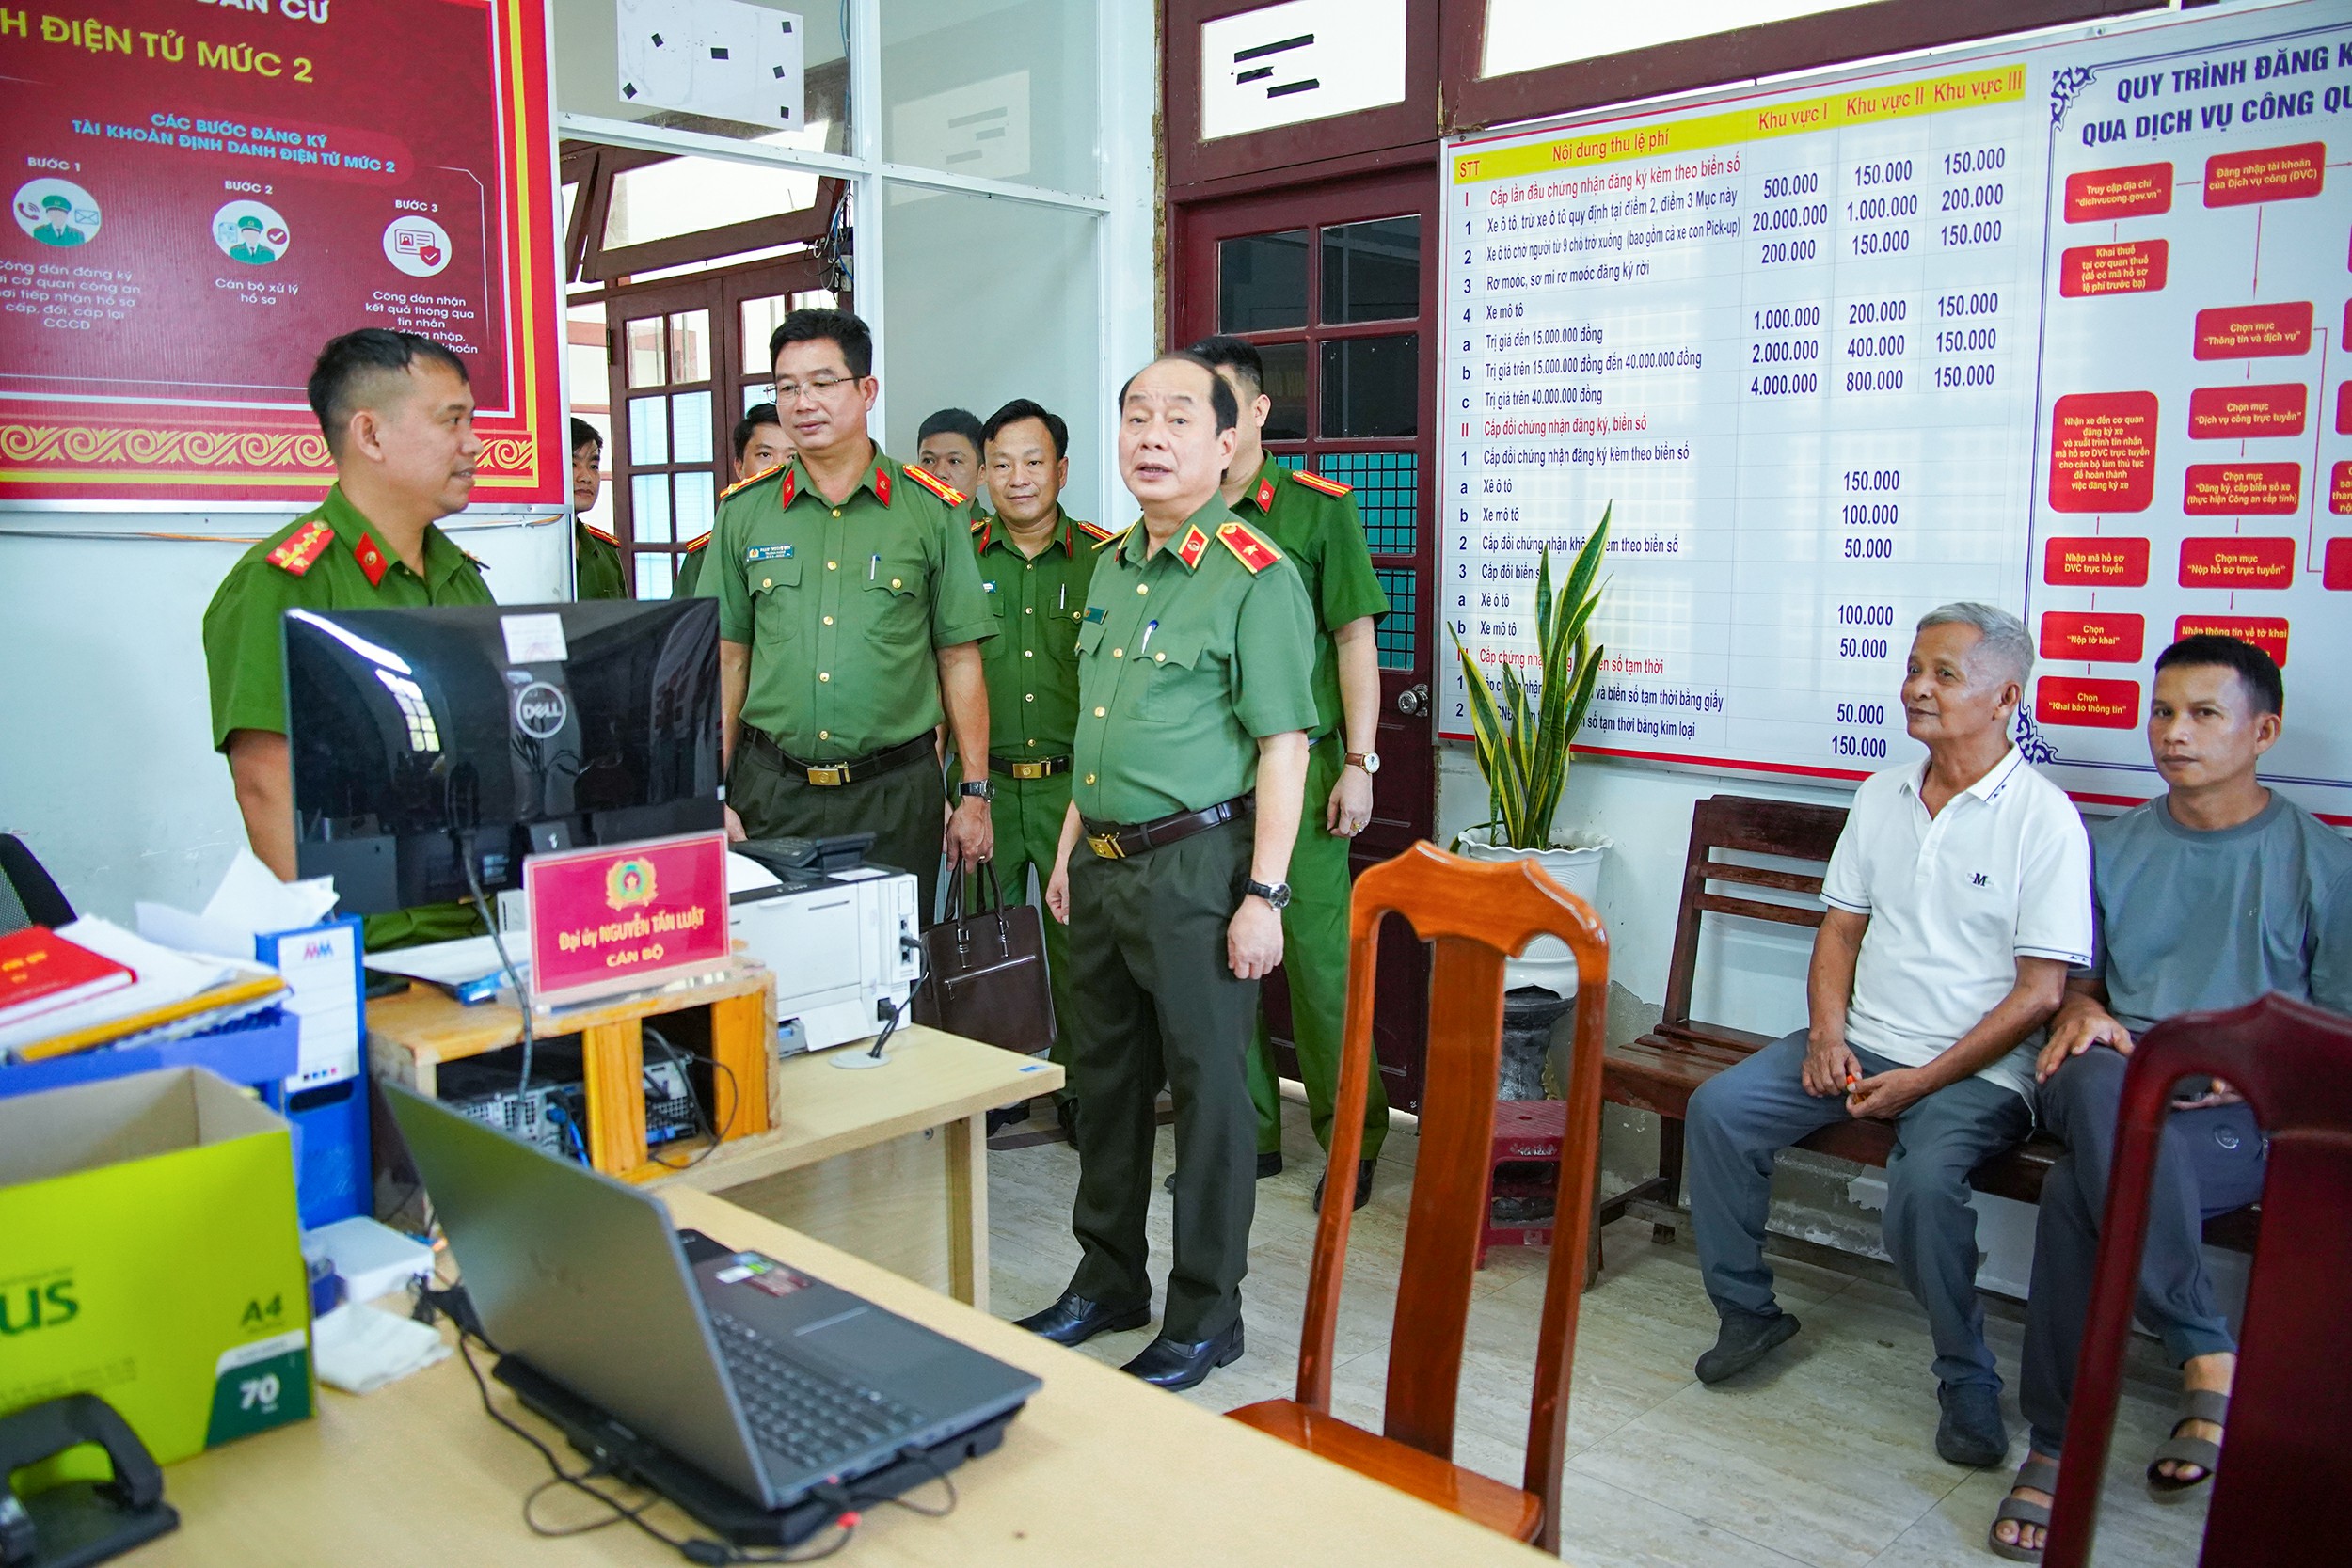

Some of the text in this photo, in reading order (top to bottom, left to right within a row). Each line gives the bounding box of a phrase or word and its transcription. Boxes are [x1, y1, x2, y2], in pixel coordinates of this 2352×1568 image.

[41, 15, 131, 54] ĐIỆN
[140, 29, 184, 61] TỬ
[197, 41, 281, 77] MỨC
[294, 57, 313, 83] 2
[2118, 72, 2164, 103] QUY
[2172, 59, 2247, 93] TRÌNH
[2255, 46, 2329, 80] ĐĂNG
[1934, 71, 2022, 103] Khu vực III
[1846, 87, 1924, 117] Khu vực II
[151, 112, 326, 148] CÁC BƯỚC ĐĂNG KÝ
[1758, 111, 1787, 131] Khu
[1791, 106, 1819, 129] vực
[2082, 118, 2127, 147] QUA
[2136, 108, 2192, 142] DỊCH
[2201, 103, 2233, 133] VỤ
[2242, 91, 2314, 123] CÔNG
[72, 119, 395, 173] TÀI KHOẢN ĐỊNH DANH ĐIỆN TỬ MỨC 2
[1552, 130, 1669, 163] Nội dung thu lệ phí
[27, 155, 81, 172] BƯỚC 1
[1459, 160, 1480, 178] STT
[1944, 147, 2005, 175] 150.000
[1490, 151, 1740, 207] Cấp lần đầu chứng nhận đăng ký kèm theo biển số
[1855, 159, 1912, 187] 150.000
[225, 181, 273, 194] BƯỚC 2
[1764, 172, 1818, 198] 500.000
[2086, 184, 2104, 196] Truy
[2106, 182, 2122, 195] cập
[2123, 179, 2136, 192] địa
[395, 199, 438, 213] BƯỚC 3
[1847, 194, 1917, 222] 1.000.000
[1942, 183, 2004, 212] 200.000
[1753, 204, 1828, 232] 20.000.000
[1852, 230, 1910, 255] 150.000
[1941, 219, 2002, 246] 150.000
[1761, 239, 1816, 263] 200.000
[215, 278, 299, 295] Cán bộ xử lý
[365, 302, 474, 319] kết quả thông qua
[373, 291, 466, 307] Công dân nhận
[1937, 293, 1998, 317] 150.000
[397, 316, 412, 326] tin
[1463, 309, 1470, 322] 4
[1486, 302, 1524, 320] Xe mô tô
[1754, 307, 1820, 330] 1.000.000
[1849, 300, 1906, 324] 200.000
[44, 318, 90, 329] CCCD
[1463, 340, 1470, 351] a
[1486, 323, 1603, 352] Trị giá đến 15.000.000 đồng
[1848, 335, 1905, 357] 400.000
[1935, 328, 1996, 352] 150.000
[1752, 340, 1819, 363] 2.000.000
[1751, 373, 1817, 396] 4.000.000
[1846, 370, 1903, 391] 800.000
[1934, 364, 1994, 388] 150.000
[1461, 423, 1469, 437] II
[1485, 415, 1501, 438] Cấp
[1518, 418, 1546, 437] chứng
[1549, 418, 1570, 436] nhận
[1573, 417, 1596, 436] đăng
[1597, 417, 1611, 436] ký,
[1635, 412, 1646, 430] số
[1843, 470, 1899, 491] 150.000
[1842, 504, 1899, 525] 100.000
[1844, 538, 1892, 558] 50.000
[2065, 552, 2086, 562] Nhập
[2114, 553, 2124, 562] sơ
[2064, 562, 2123, 574] DVC trực tuyến
[1837, 605, 1893, 626] 100.000
[2083, 626, 2104, 634] Chọn
[2089, 635, 2099, 644] tờ
[1840, 638, 1887, 658] 50.000
[2077, 693, 2098, 703] Chọn
[2089, 703, 2110, 714] thông
[522, 704, 562, 719] DELL
[1836, 703, 1884, 724] 50.000
[1832, 736, 1886, 758] 150.000
[1973, 873, 1988, 886] M
[559, 928, 580, 952] Đại
[599, 911, 650, 943] NGUYỄN
[652, 909, 675, 933] TẤN
[677, 905, 705, 930] LUẬT
[607, 944, 664, 967] CÁN BỘ
[241, 1293, 282, 1328] A4
[240, 1374, 280, 1411] 70
